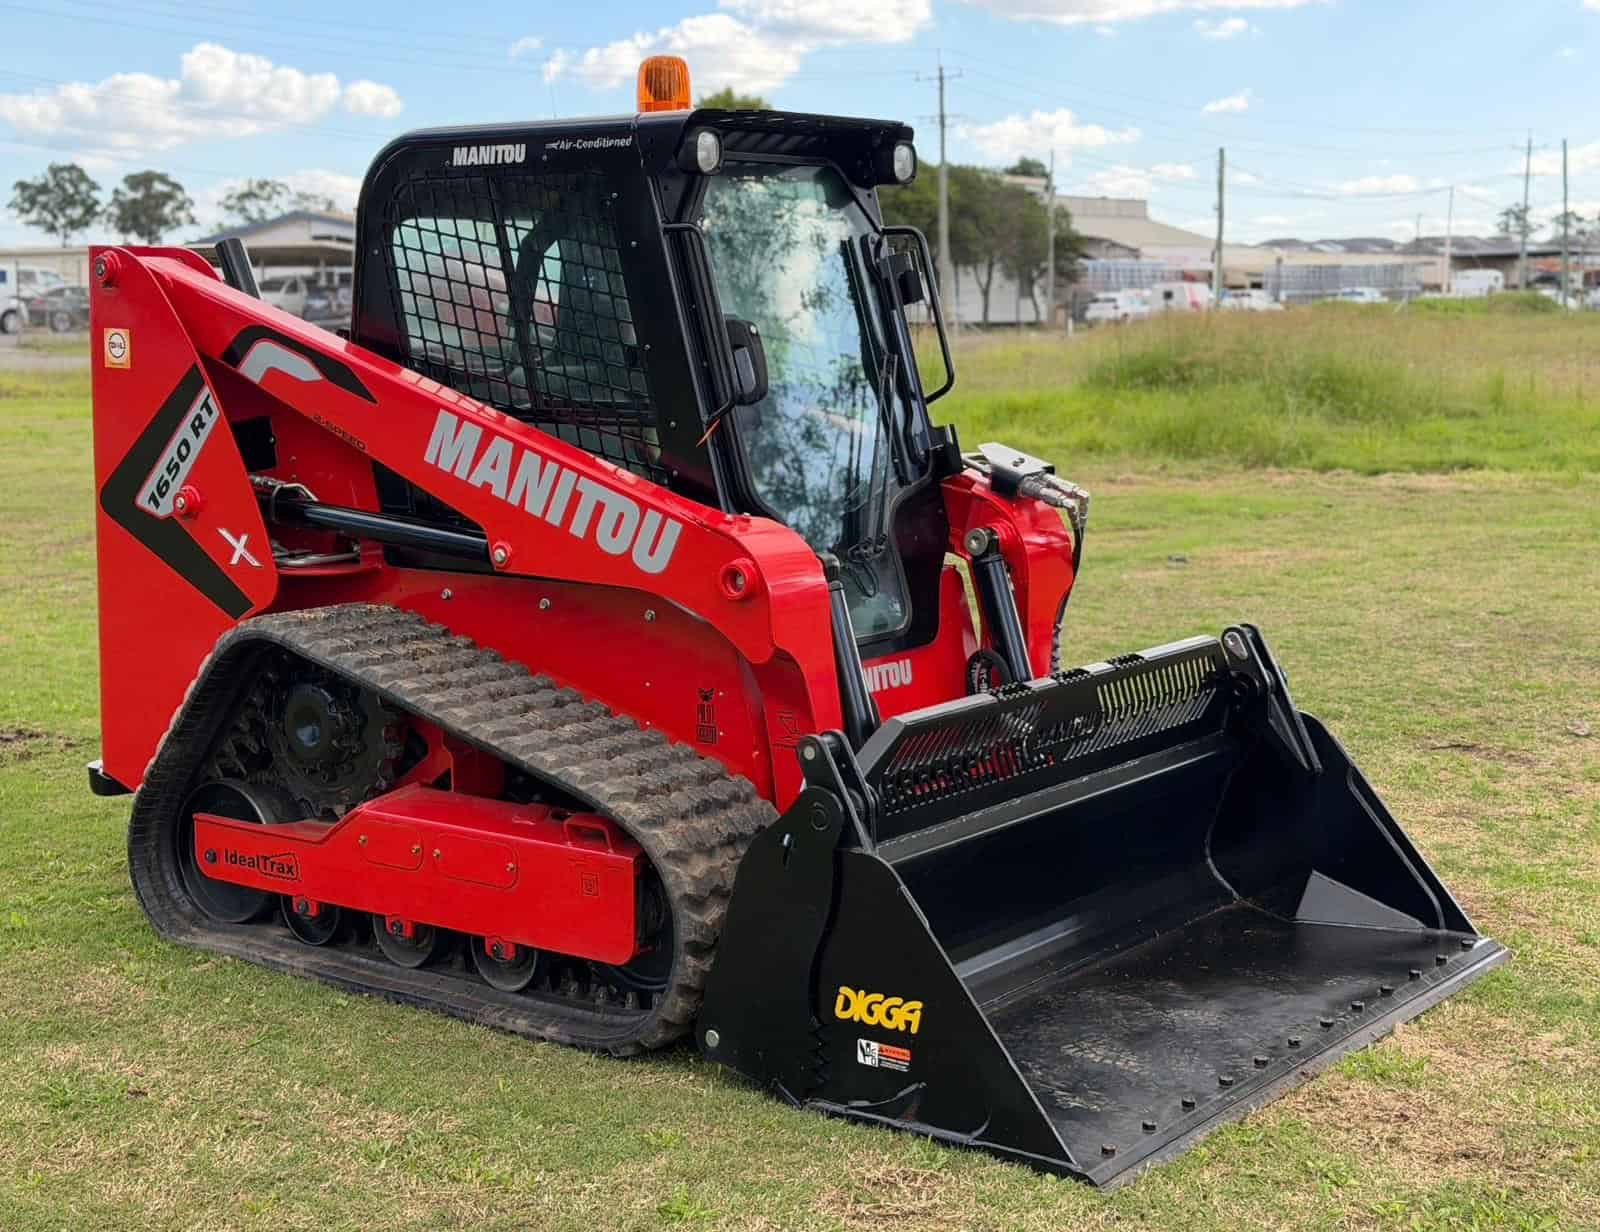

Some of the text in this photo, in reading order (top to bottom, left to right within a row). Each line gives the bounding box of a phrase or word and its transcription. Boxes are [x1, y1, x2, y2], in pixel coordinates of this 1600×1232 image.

[453, 143, 527, 166] MANITOU
[558, 135, 633, 150] Air-Conditioned
[148, 394, 214, 510] 1650 RT
[423, 408, 683, 575] MANITOU
[216, 527, 263, 568] X
[863, 658, 912, 693] NITOU
[224, 848, 296, 877] IdealTrax
[834, 985, 923, 1034] DIGGA
